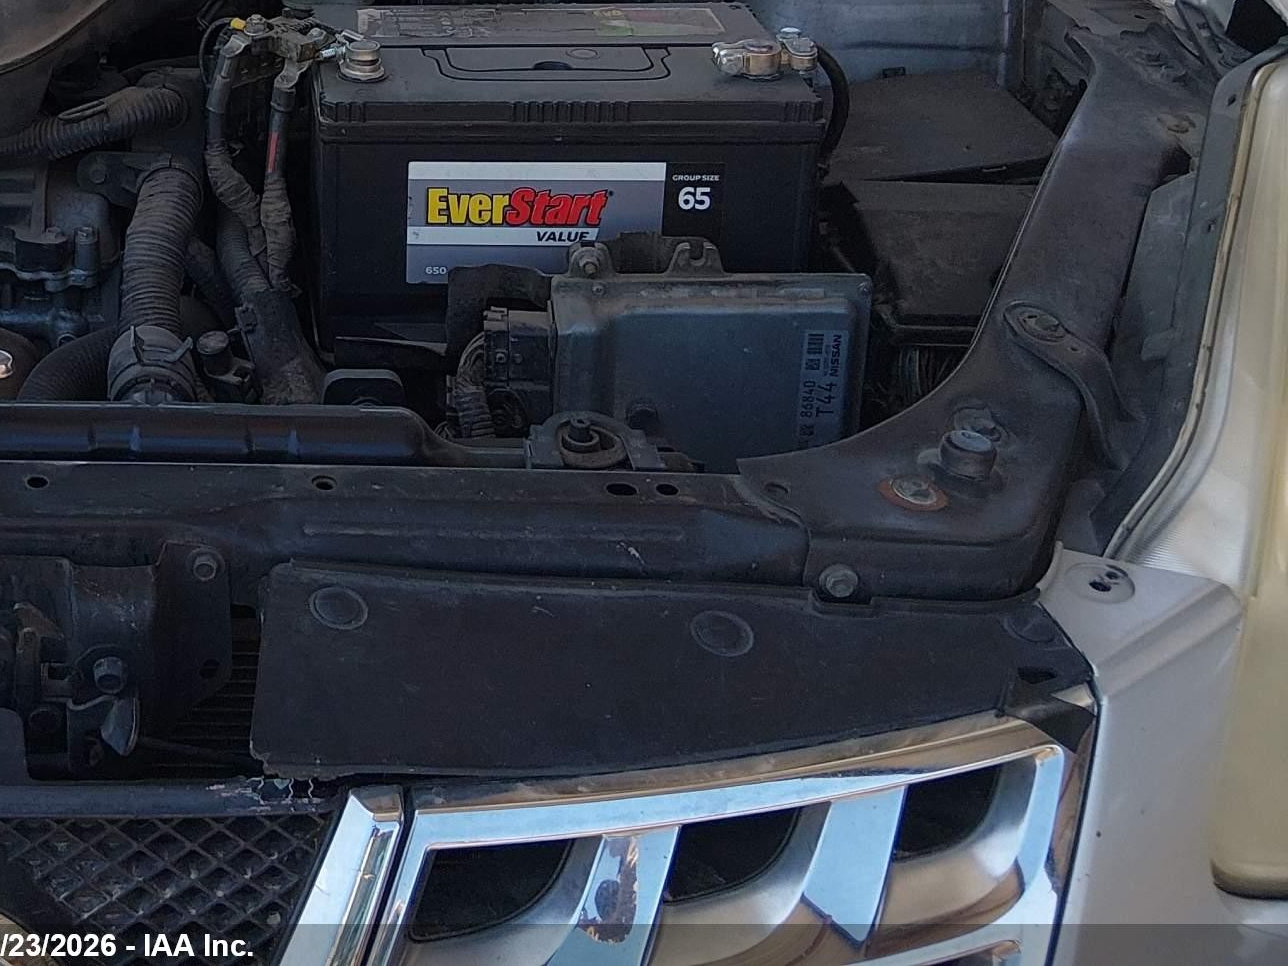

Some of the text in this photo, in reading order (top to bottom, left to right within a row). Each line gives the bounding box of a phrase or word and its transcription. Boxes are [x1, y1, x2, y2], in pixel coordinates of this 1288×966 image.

[672, 174, 720, 182] GROUP SIZE
[426, 186, 609, 227] EverStart
[678, 186, 711, 210] 65
[536, 230, 590, 242] VALUE
[425, 266, 447, 275] 650
[829, 334, 842, 377] NISSAN
[800, 380, 816, 418] 86840
[815, 381, 837, 418] T44
